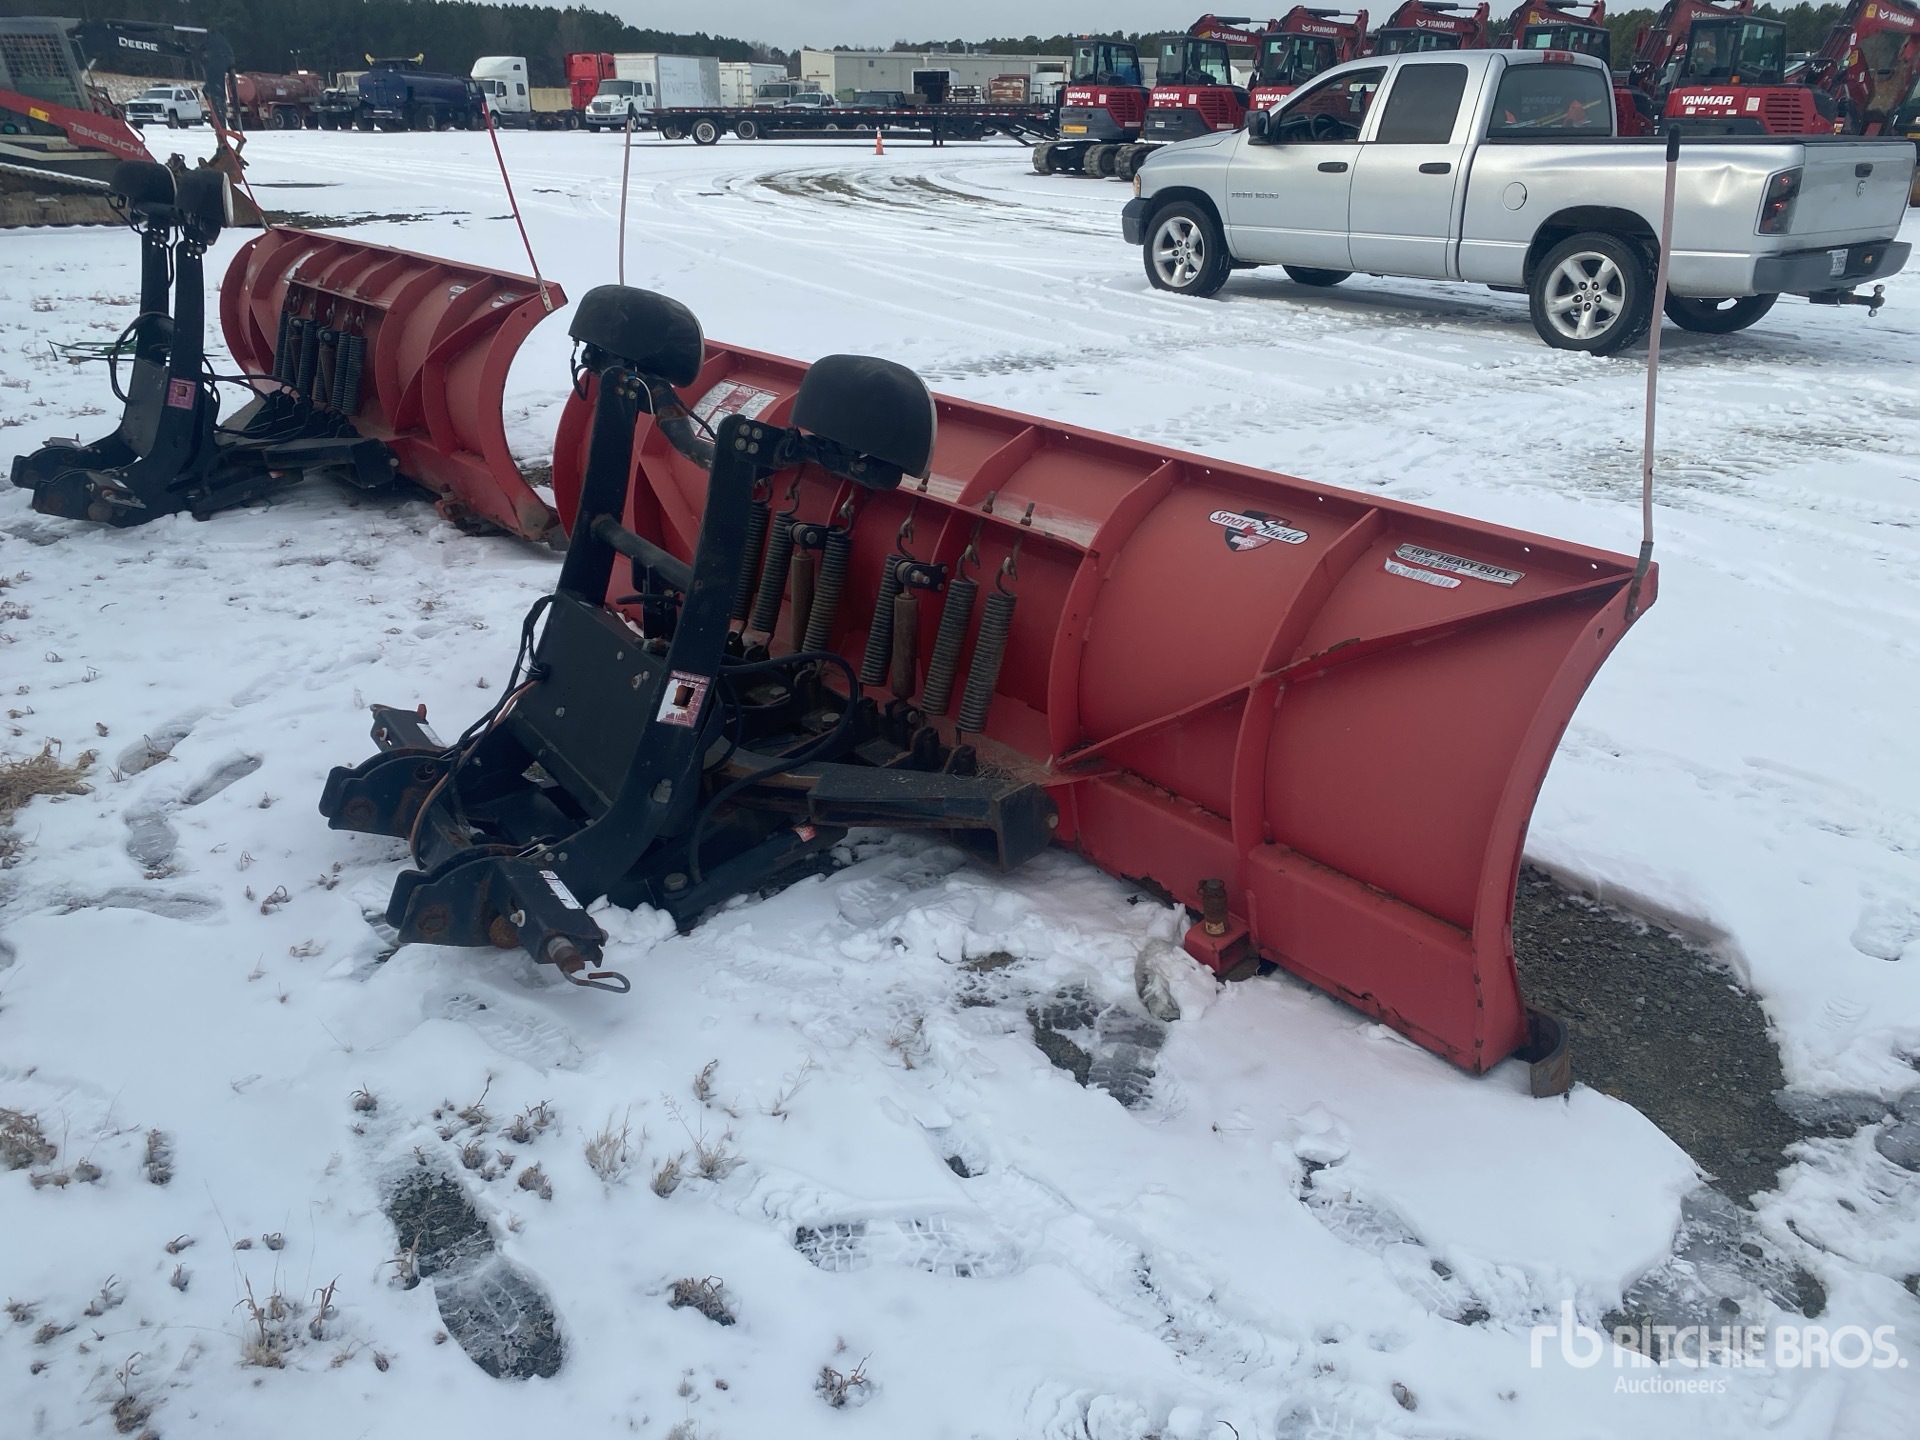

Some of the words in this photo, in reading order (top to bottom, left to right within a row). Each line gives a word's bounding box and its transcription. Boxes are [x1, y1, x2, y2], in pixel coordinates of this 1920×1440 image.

[1889, 11, 1915, 27] YANMAR
[1311, 25, 1338, 34] YANMAR
[1427, 20, 1455, 29] YANMAR
[1221, 33, 1248, 42] YANMAR
[118, 36, 159, 52] DEERE
[1682, 96, 1734, 106] YANMAR
[1438, 554, 1478, 570] HEAVY
[1478, 565, 1512, 578] DUTY
